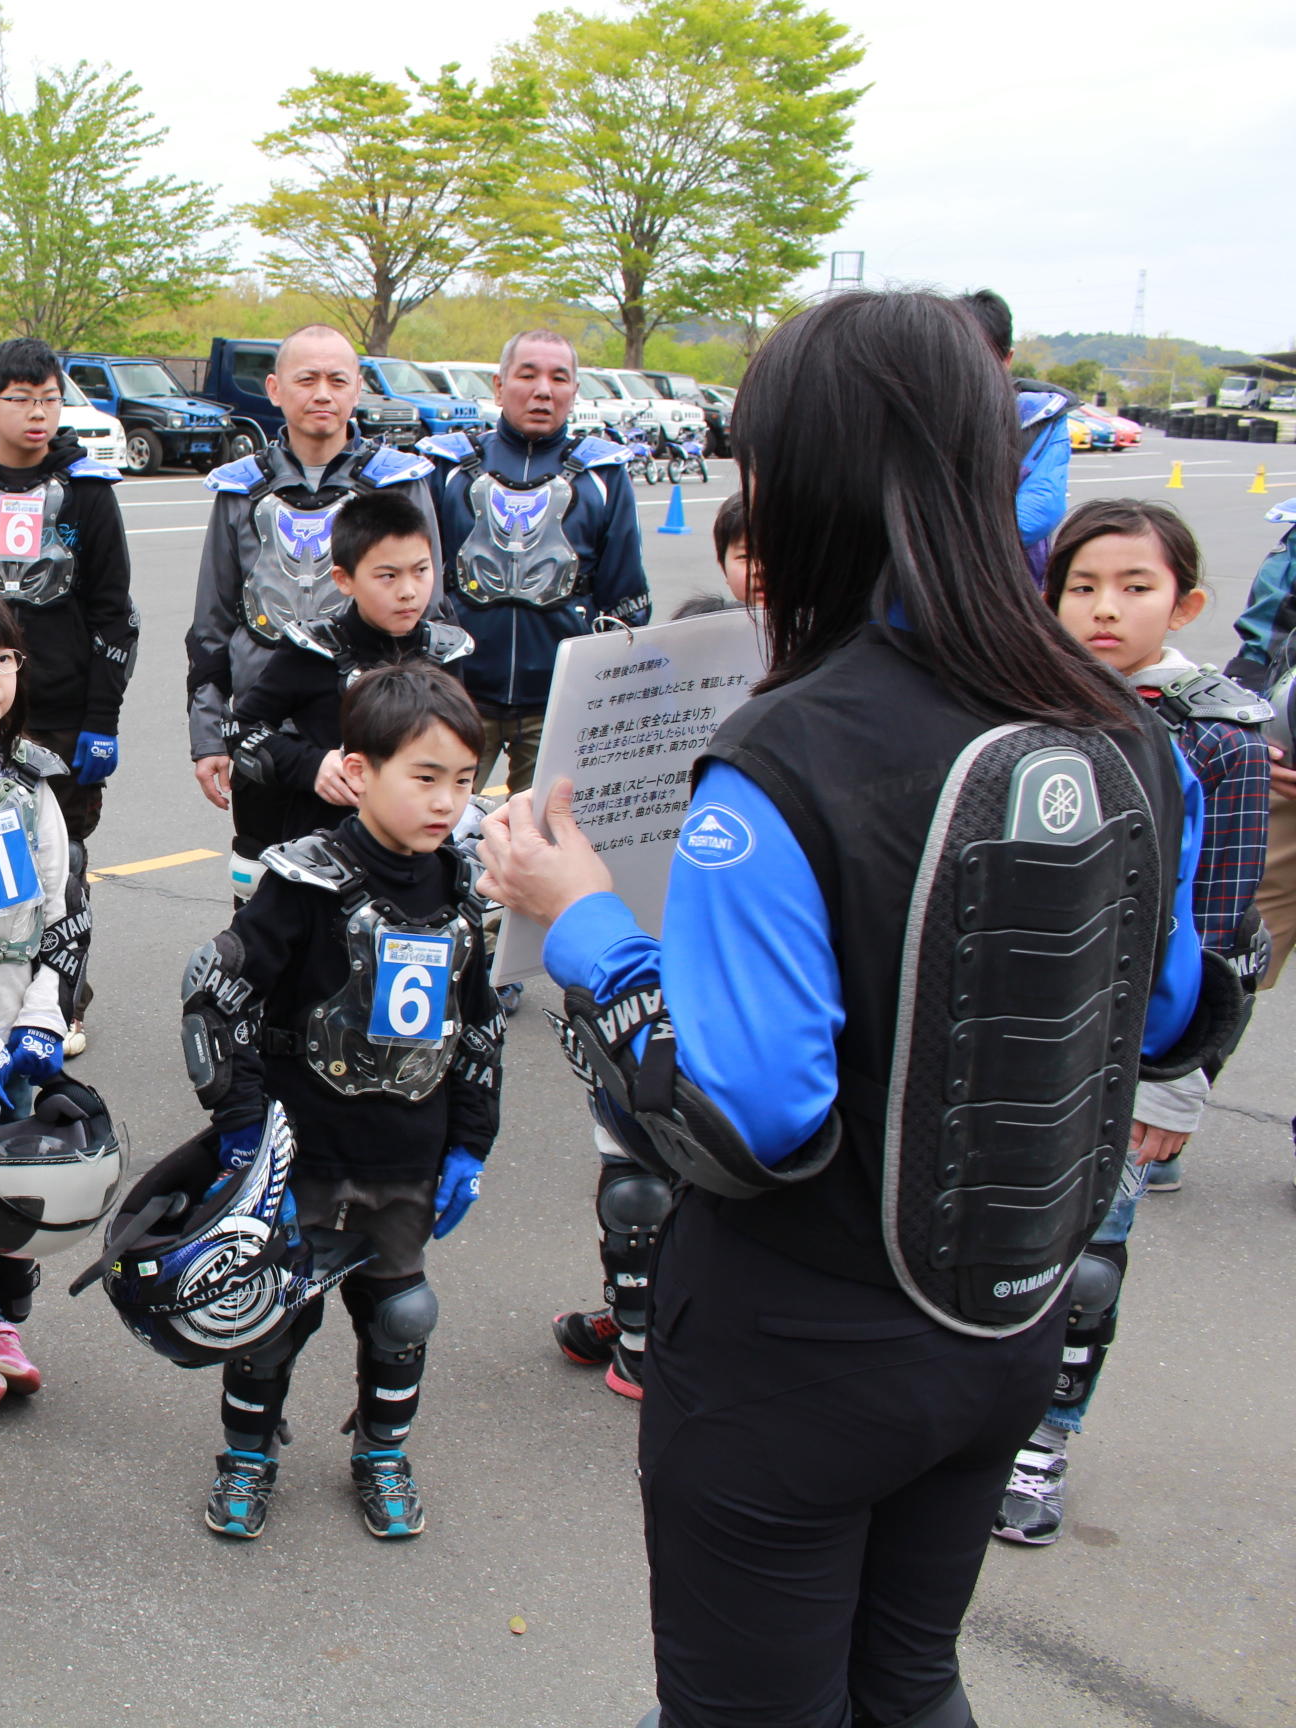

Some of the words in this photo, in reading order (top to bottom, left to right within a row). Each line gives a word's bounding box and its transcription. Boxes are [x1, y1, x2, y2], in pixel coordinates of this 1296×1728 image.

[5, 513, 34, 555] 6
[388, 964, 433, 1036] 6
[334, 1064, 341, 1072] S
[1012, 1266, 1055, 1295] YAMAHA
